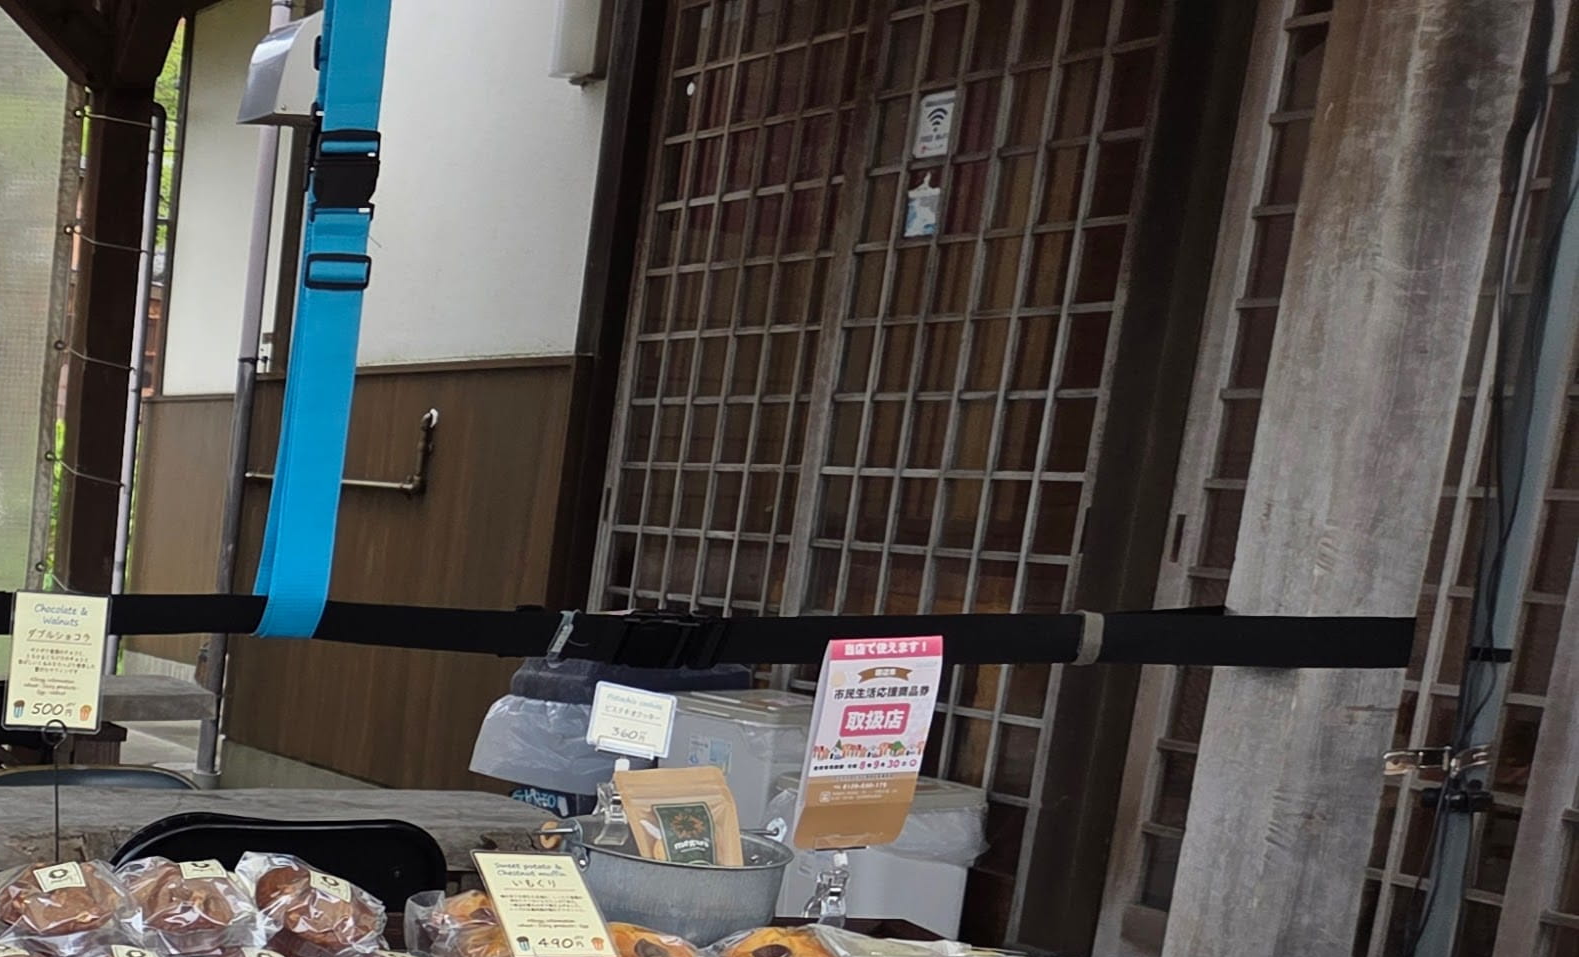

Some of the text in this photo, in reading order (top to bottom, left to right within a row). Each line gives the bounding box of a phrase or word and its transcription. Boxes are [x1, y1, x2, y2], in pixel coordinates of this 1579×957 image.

[34, 603, 77, 615] Chocolate
[42, 618, 79, 627] Walnuts
[28, 628, 91, 642] ダブルショコラ
[834, 685, 929, 699] 市民生活応援商品券
[31, 703, 64, 716] 500
[845, 709, 904, 731] 取扱店
[612, 726, 638, 740] 360
[511, 879, 556, 888] いもくり
[538, 938, 574, 949] 490
